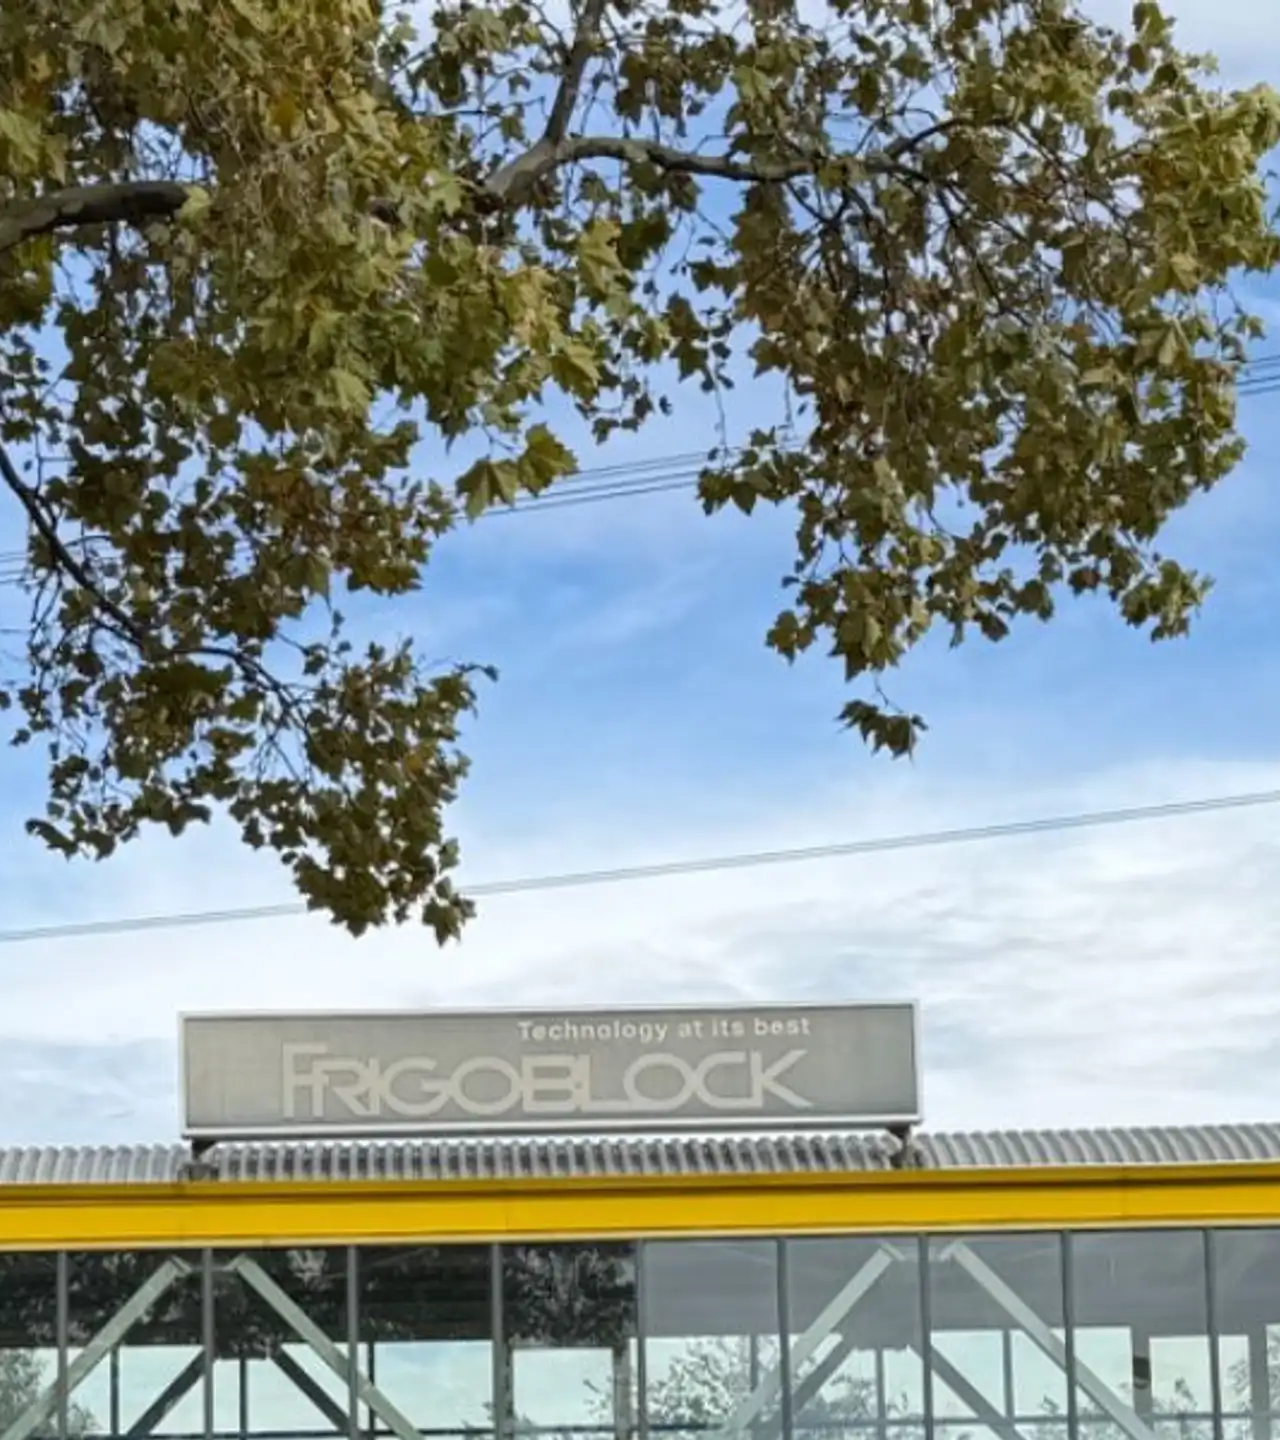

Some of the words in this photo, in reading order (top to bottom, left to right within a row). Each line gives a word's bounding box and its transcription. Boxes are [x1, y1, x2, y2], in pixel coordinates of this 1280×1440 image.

[518, 1019, 668, 1042] Technology
[677, 1019, 705, 1038] at
[754, 1017, 810, 1036] best
[282, 1043, 813, 1118] FRIGOBLOCK
